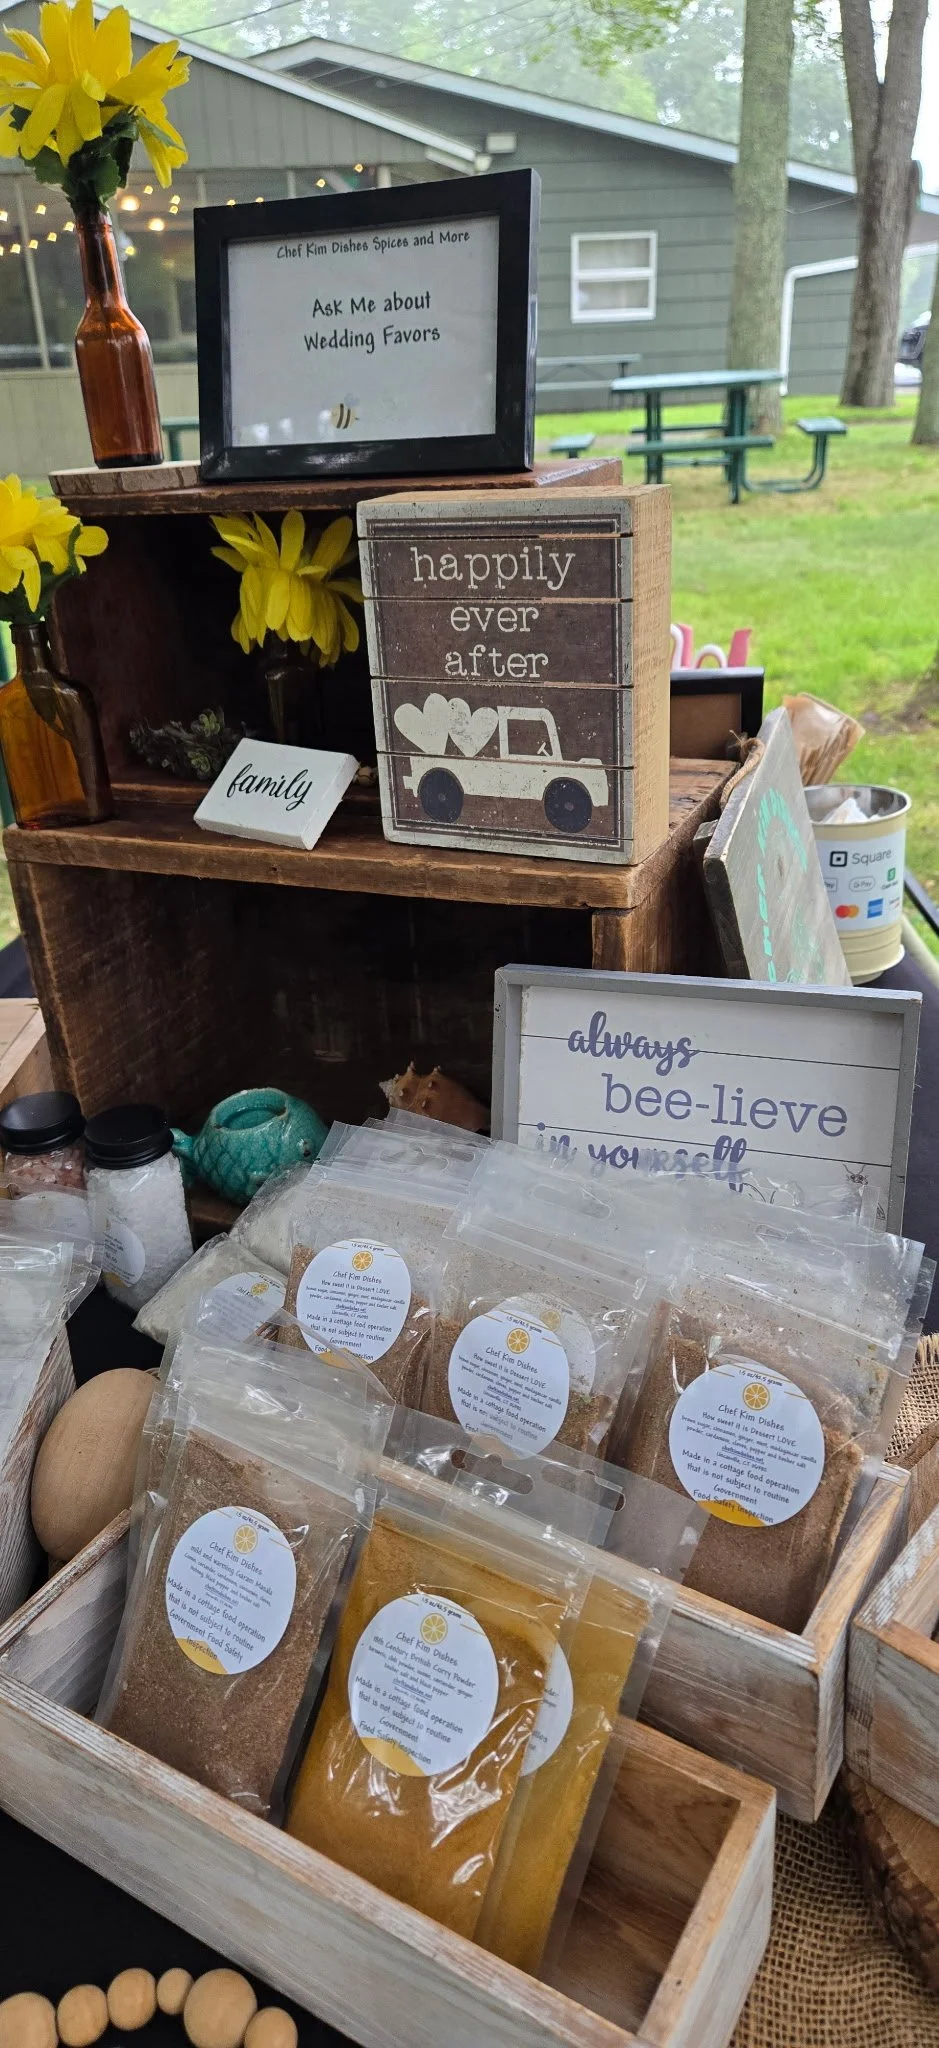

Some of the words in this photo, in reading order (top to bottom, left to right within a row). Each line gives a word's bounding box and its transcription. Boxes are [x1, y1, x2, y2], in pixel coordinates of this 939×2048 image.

[277, 244, 302, 259] Chef
[306, 242, 327, 258] Kim
[332, 240, 368, 254] Dishes
[373, 236, 408, 254] Spices
[414, 231, 434, 245] and
[440, 230, 470, 243] More
[313, 298, 343, 318] Ask
[351, 297, 375, 314] Me
[384, 291, 431, 311] about
[304, 328, 375, 354] Wedding
[383, 325, 440, 345] Favors
[410, 546, 576, 590] happily
[451, 607, 539, 632] ever
[445, 644, 549, 678] after
[227, 764, 312, 811] family
[852, 850, 891, 866] Square
[567, 1011, 700, 1076] always
[601, 1073, 847, 1137] bee-lieve
[534, 1122, 577, 1156] in
[363, 1275, 382, 1284] Dishes
[330, 1337, 361, 1347] Government
[334, 1319, 352, 1328] cottage
[368, 1324, 391, 1332] operation
[486, 1347, 501, 1358] Chef
[502, 1353, 514, 1363] Kim
[517, 1359, 537, 1373] Dishes
[510, 1370, 529, 1380] Dessert
[531, 1378, 546, 1388] LOVE
[458, 1387, 471, 1397] Made
[486, 1401, 504, 1414] cottage
[506, 1409, 519, 1419] food
[520, 1418, 546, 1432] operation
[718, 1404, 738, 1416] Chef
[740, 1410, 755, 1422] Kim
[759, 1417, 785, 1431] Dishes
[702, 1412, 715, 1420] How
[717, 1418, 734, 1426] sweet
[751, 1428, 775, 1440] Dessert
[778, 1435, 797, 1447] LOVE
[682, 1449, 701, 1460] Made
[704, 1456, 710, 1464] in
[720, 1464, 744, 1477] cottage
[748, 1470, 763, 1482] food
[766, 1479, 800, 1494] operation
[687, 1463, 701, 1473] that
[726, 1478, 751, 1489] subject
[754, 1486, 761, 1494] to
[764, 1491, 790, 1503] routine
[693, 1489, 711, 1500] Food
[714, 1496, 736, 1512] Safety
[738, 1507, 774, 1523] Inspection
[714, 1484, 757, 1505] Government
[202, 1553, 213, 1561] and
[214, 1559, 235, 1576] warming
[236, 1570, 254, 1584] Garam
[255, 1581, 273, 1596] Masala
[210, 1542, 226, 1555] Chef
[226, 1550, 239, 1562] Kim
[241, 1558, 263, 1575] Dishes
[168, 1577, 183, 1591] Made
[185, 1588, 190, 1597] in
[198, 1598, 220, 1615] cottage
[223, 1609, 238, 1624] food
[238, 1621, 266, 1642] operation
[169, 1592, 180, 1605] that
[181, 1601, 187, 1610] is
[189, 1607, 199, 1617] not
[200, 1615, 223, 1632] subject
[225, 1627, 231, 1636] to
[232, 1634, 254, 1651] routine
[170, 1609, 205, 1637] Government
[207, 1632, 224, 1647] Food
[225, 1642, 243, 1664] Safety
[187, 1636, 218, 1660] Inspection
[396, 1632, 415, 1645] Chef
[416, 1640, 431, 1653] Kim
[433, 1649, 458, 1666] Dishes
[385, 1641, 408, 1659] Century
[411, 1653, 431, 1667] British
[433, 1664, 451, 1680] Curry
[453, 1672, 476, 1689] Powder
[356, 1676, 373, 1689] Made
[374, 1684, 380, 1693] in
[388, 1694, 411, 1710] cottage
[414, 1704, 430, 1718] food
[431, 1715, 463, 1734] operation
[358, 1691, 370, 1702] that
[380, 1704, 391, 1712] not
[392, 1711, 415, 1726] subject
[417, 1721, 424, 1730] to
[426, 1728, 451, 1742] routine
[360, 1721, 375, 1734] Food
[377, 1730, 397, 1751] Safety
[399, 1740, 431, 1764] Inspection
[379, 1717, 419, 1742] Government
